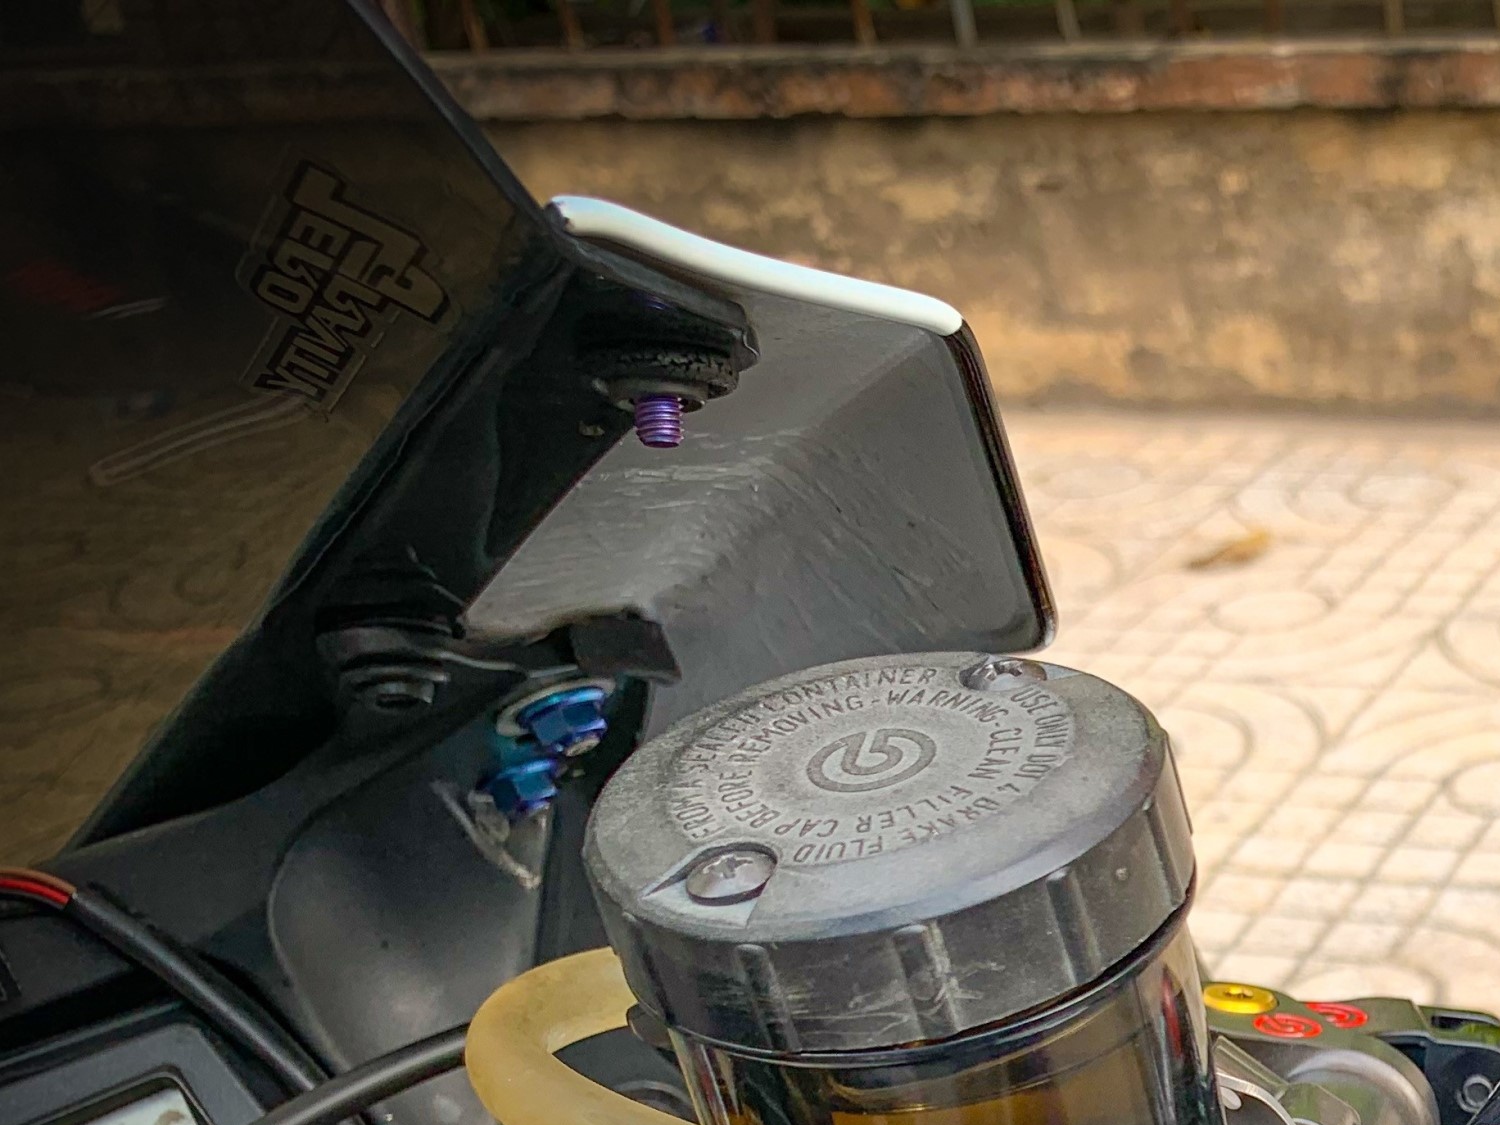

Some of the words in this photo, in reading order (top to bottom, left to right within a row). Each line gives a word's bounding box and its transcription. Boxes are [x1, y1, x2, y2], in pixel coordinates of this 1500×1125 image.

[763, 667, 938, 712] CONTAINER
[1011, 687, 1057, 715] USE
[1034, 714, 1068, 747] ONLY
[1013, 753, 1058, 779] DOT
[672, 793, 726, 839] FROM
[718, 769, 781, 829] BEFORE
[856, 785, 974, 834] FILLER
[774, 817, 839, 838] CAP
[897, 796, 1001, 842] BRAKE
[794, 836, 883, 862] FLUID
